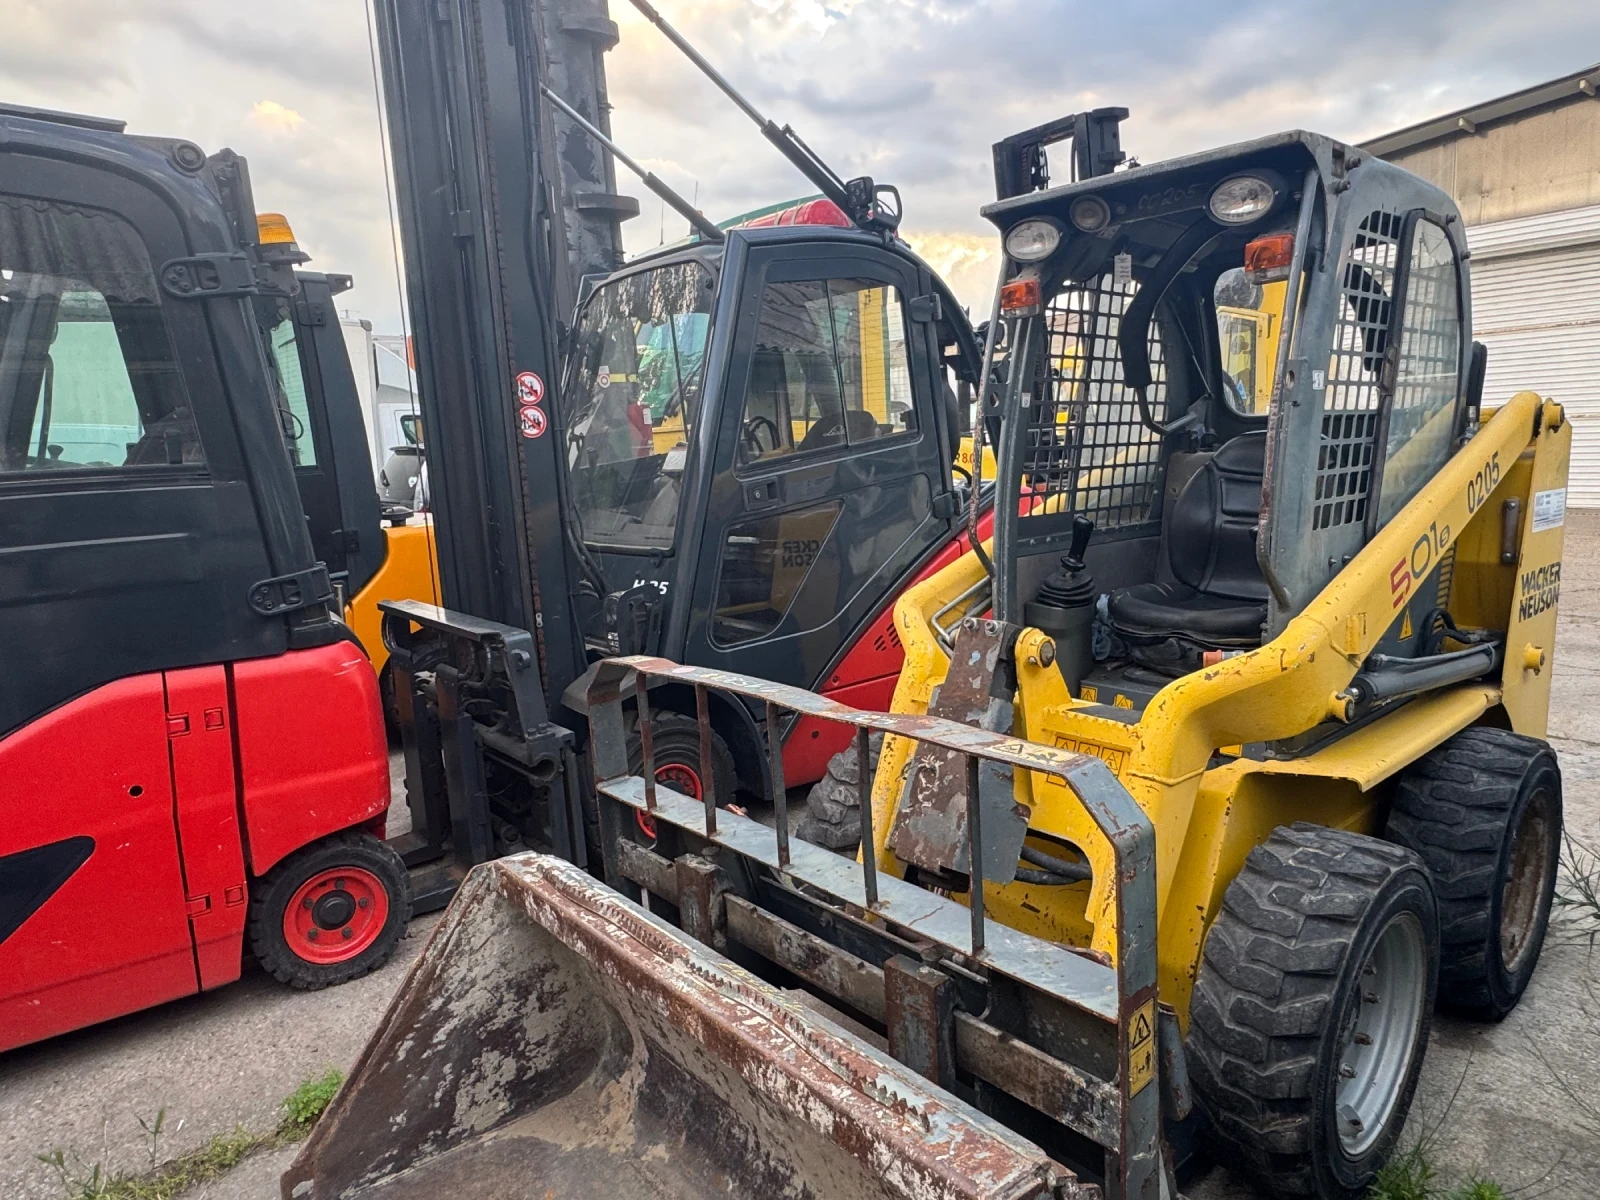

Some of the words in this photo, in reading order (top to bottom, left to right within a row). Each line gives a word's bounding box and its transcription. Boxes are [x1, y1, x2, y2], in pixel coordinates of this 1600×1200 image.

[1467, 451, 1500, 514] 0205
[1520, 561, 1562, 597] WACKER
[1518, 583, 1561, 624] NEUSON
